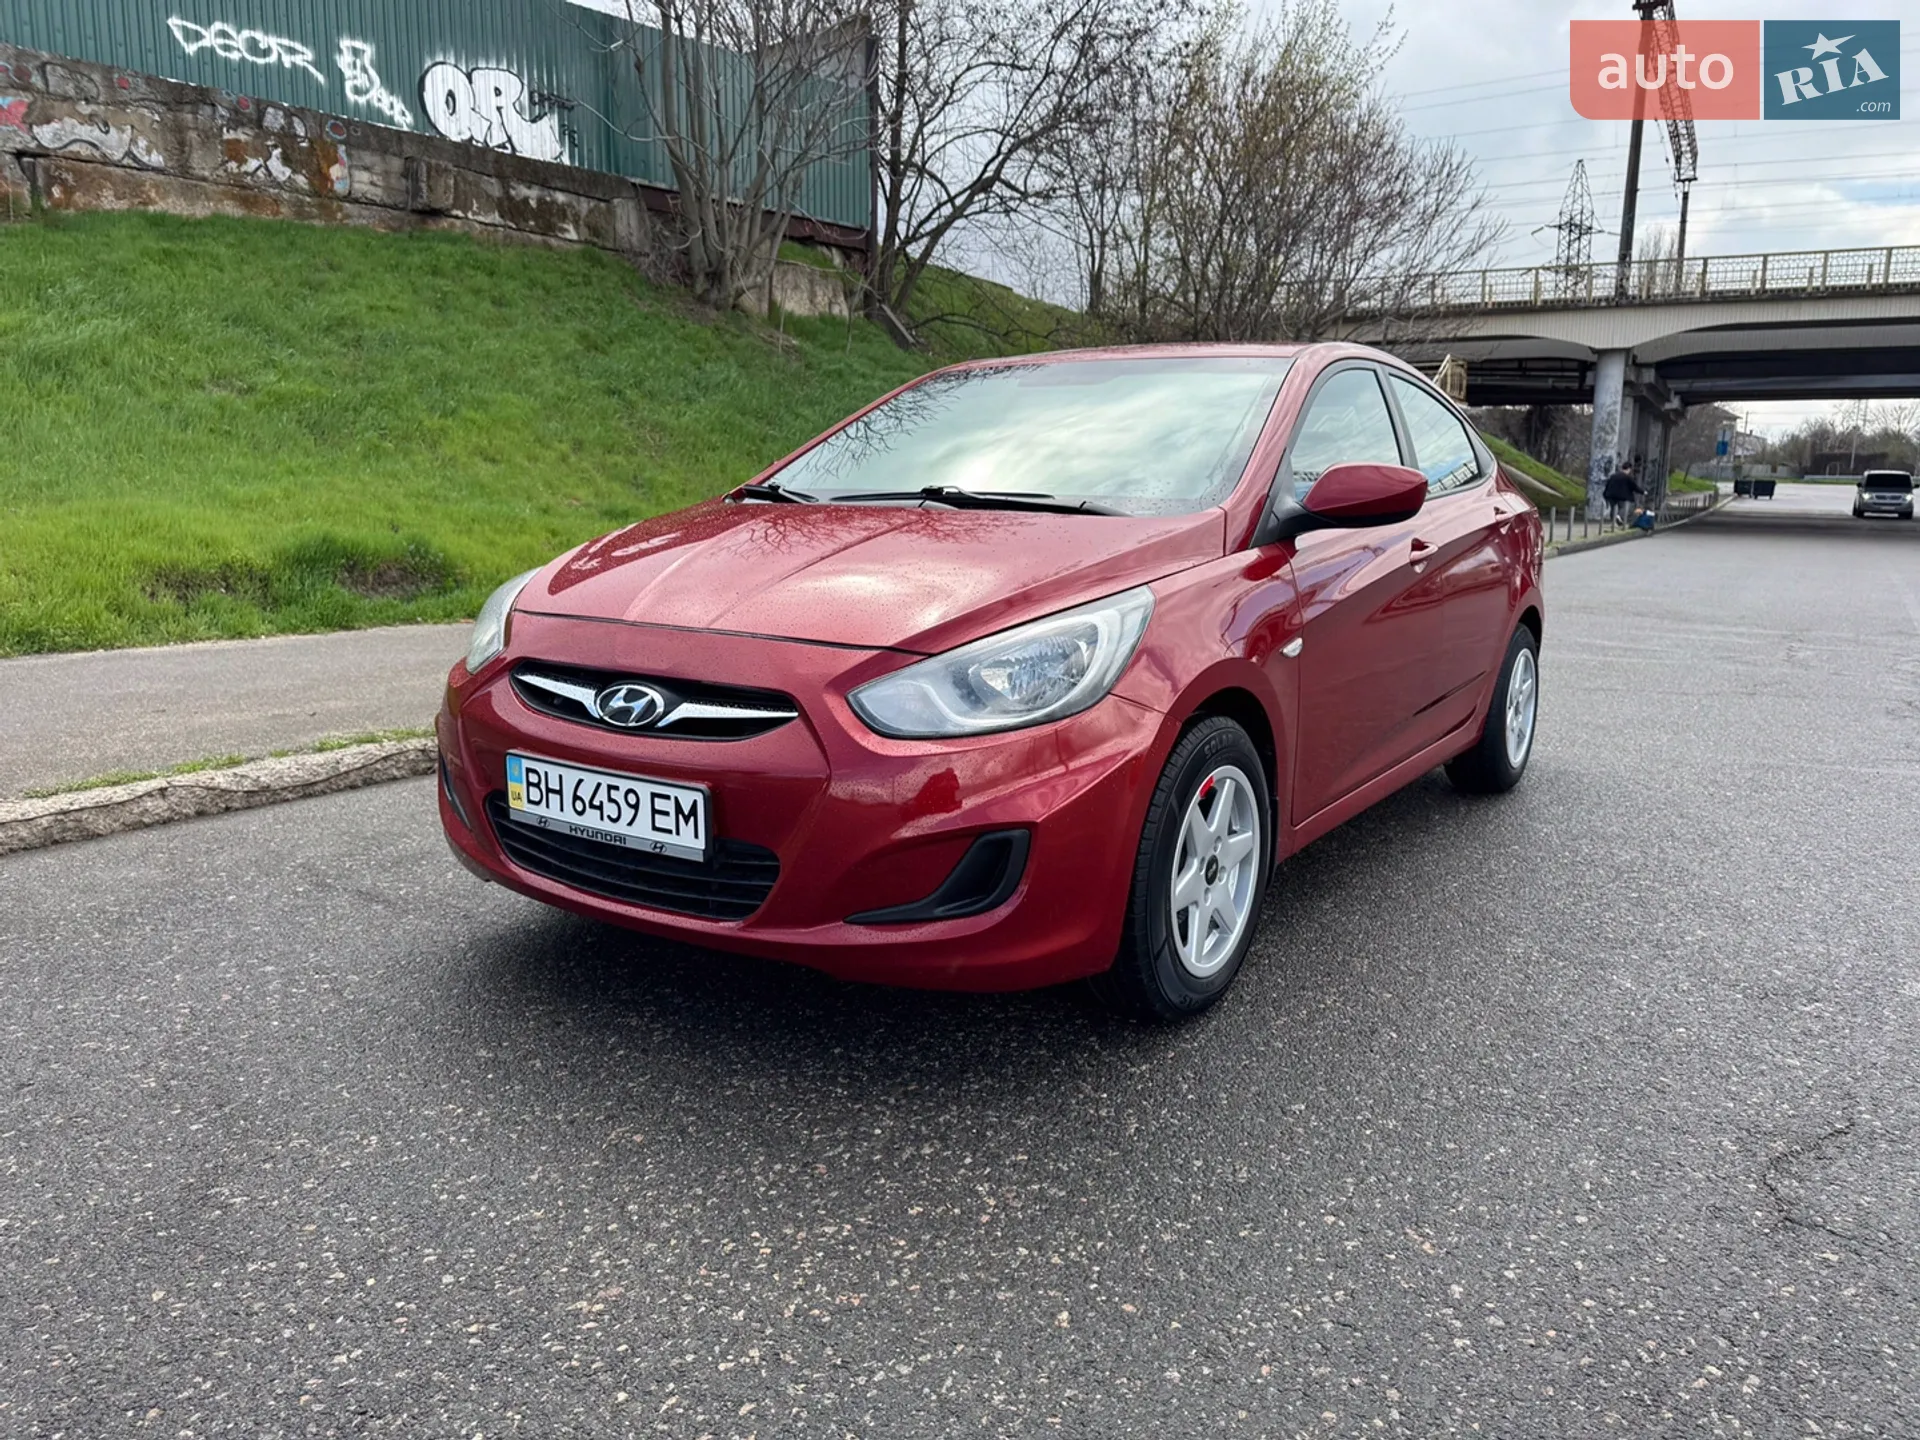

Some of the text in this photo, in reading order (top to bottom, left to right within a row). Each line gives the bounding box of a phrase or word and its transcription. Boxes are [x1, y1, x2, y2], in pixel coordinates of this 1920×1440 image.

[511, 790, 522, 801] UA
[525, 767, 699, 839] BH 6459 EM
[569, 825, 627, 845] HYUNDAI
